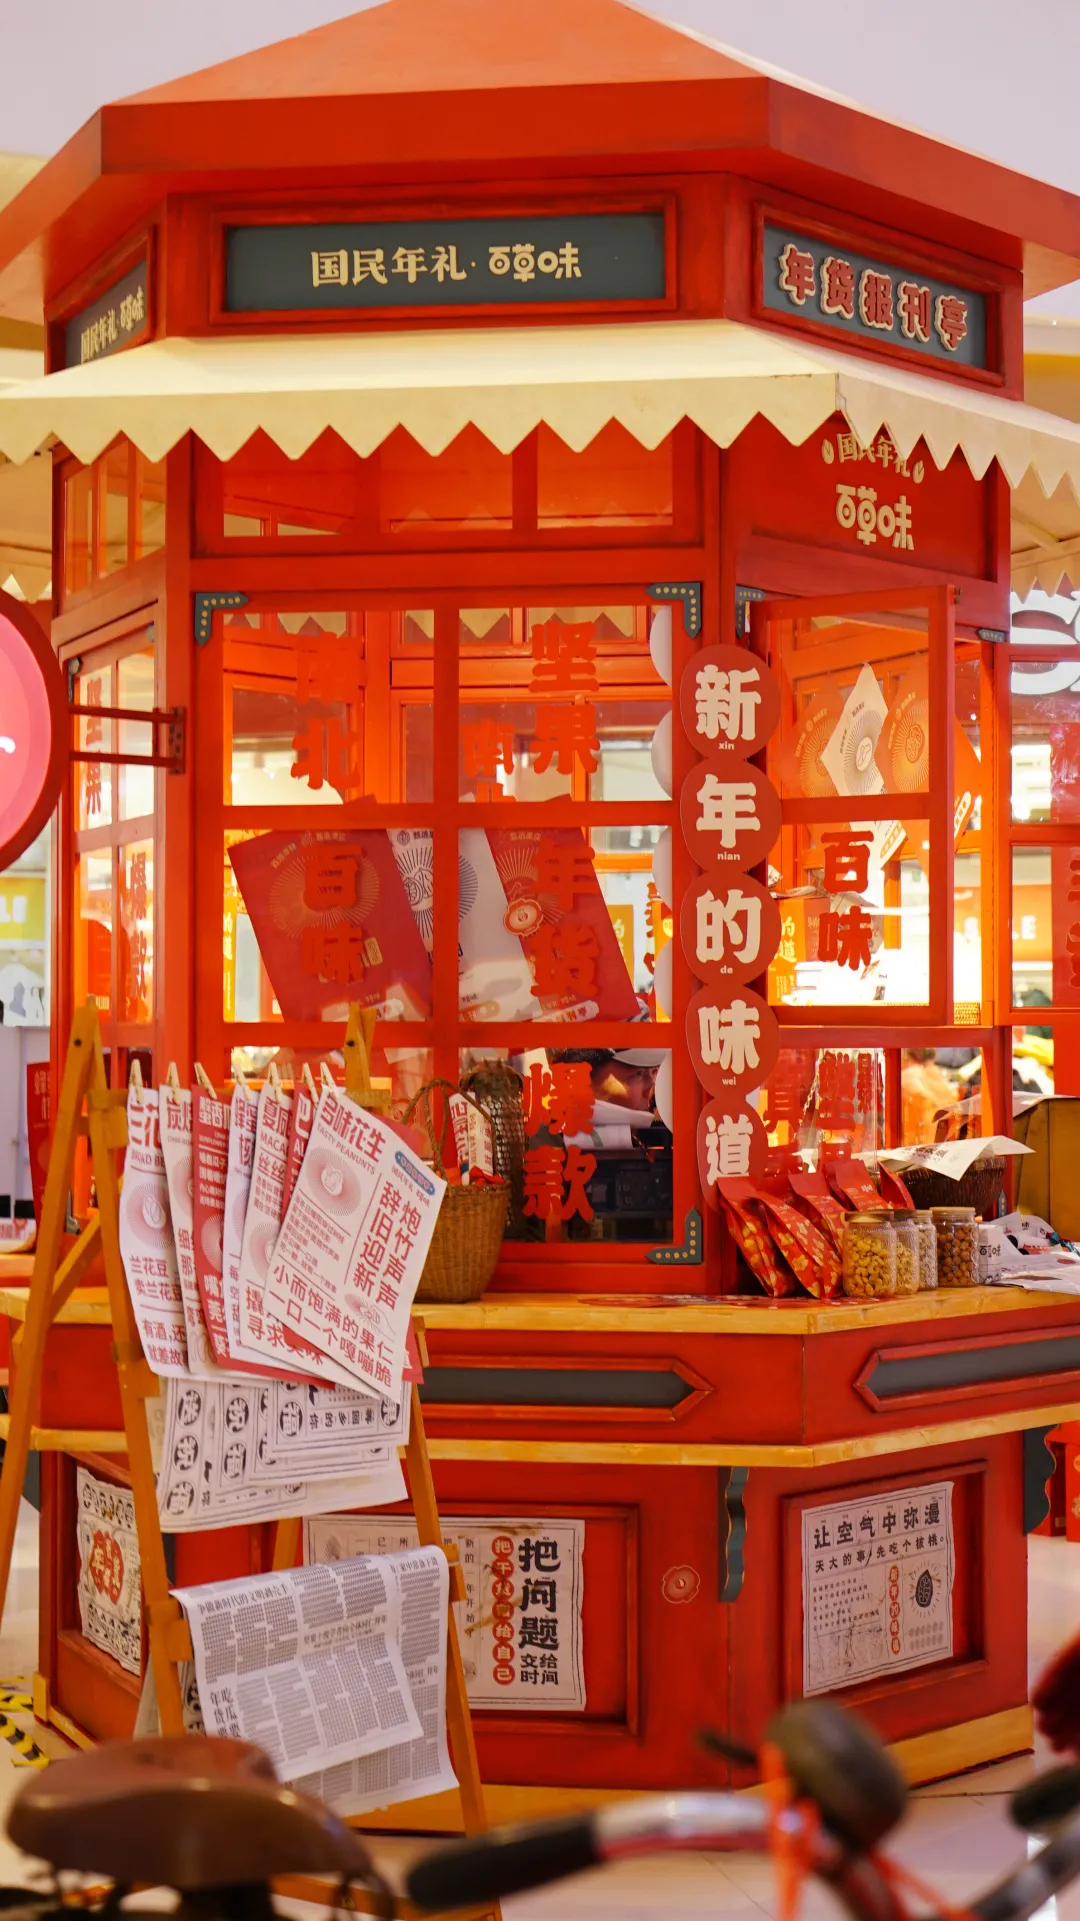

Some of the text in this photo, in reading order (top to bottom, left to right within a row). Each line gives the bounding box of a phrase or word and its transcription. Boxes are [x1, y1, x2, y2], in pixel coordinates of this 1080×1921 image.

[778, 242, 968, 351] 年货报刊亭
[836, 483, 914, 550] 百草味
[718, 741, 735, 751] xin
[717, 852, 741, 861] nian
[817, 830, 874, 971] 百味
[720, 965, 733, 974] de
[722, 1076, 737, 1086] wei
[522, 1063, 598, 1222] 爆款
[129, 1256, 168, 1277] 兰花豆
[352, 1181, 402, 1297] 辞旧迎新
[376, 1201, 422, 1310] 炮竹声声
[268, 1289, 393, 1388] 一口一个嘎嘣脆
[273, 1264, 394, 1366] 小而饱满的果仁
[814, 1502, 940, 1549] 让空气中弥漫
[518, 1538, 560, 1650] 把问题
[519, 1653, 558, 1669] 交给
[520, 1670, 559, 1685] 时间
